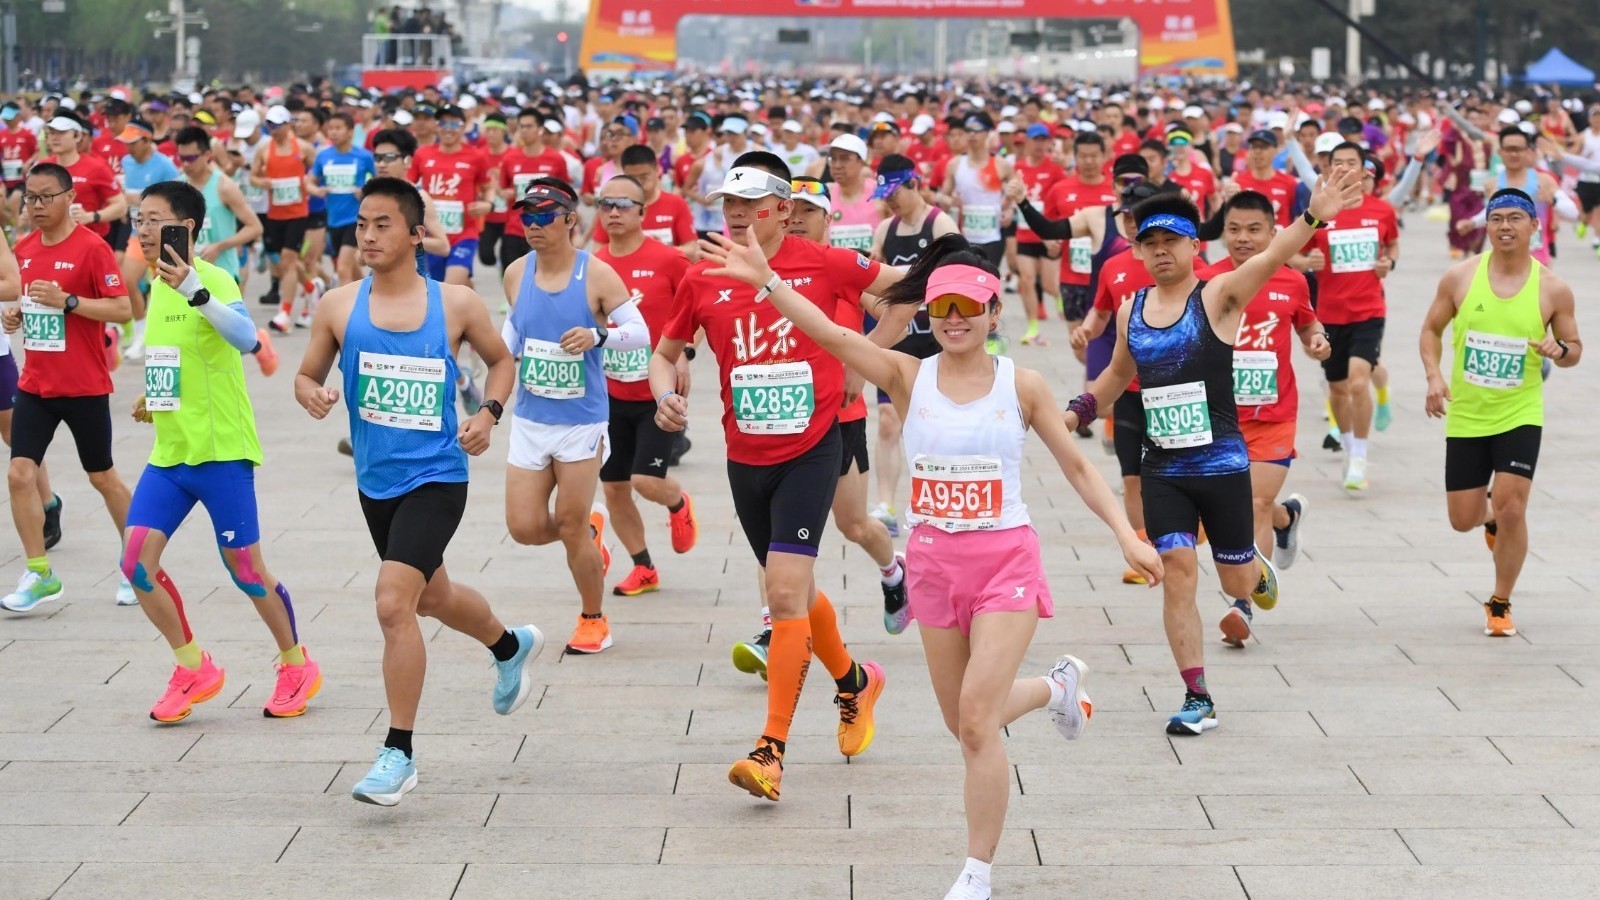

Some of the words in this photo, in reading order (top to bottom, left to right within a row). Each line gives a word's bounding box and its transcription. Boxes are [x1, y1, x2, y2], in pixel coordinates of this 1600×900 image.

[1334, 242, 1376, 264] A1150
[732, 312, 798, 362] 北京
[525, 358, 580, 383] A2080
[1467, 349, 1522, 375] A3875
[364, 378, 437, 409] A2908
[739, 386, 809, 413] A2852
[1150, 404, 1205, 431] A1905
[917, 481, 992, 511] A9561
